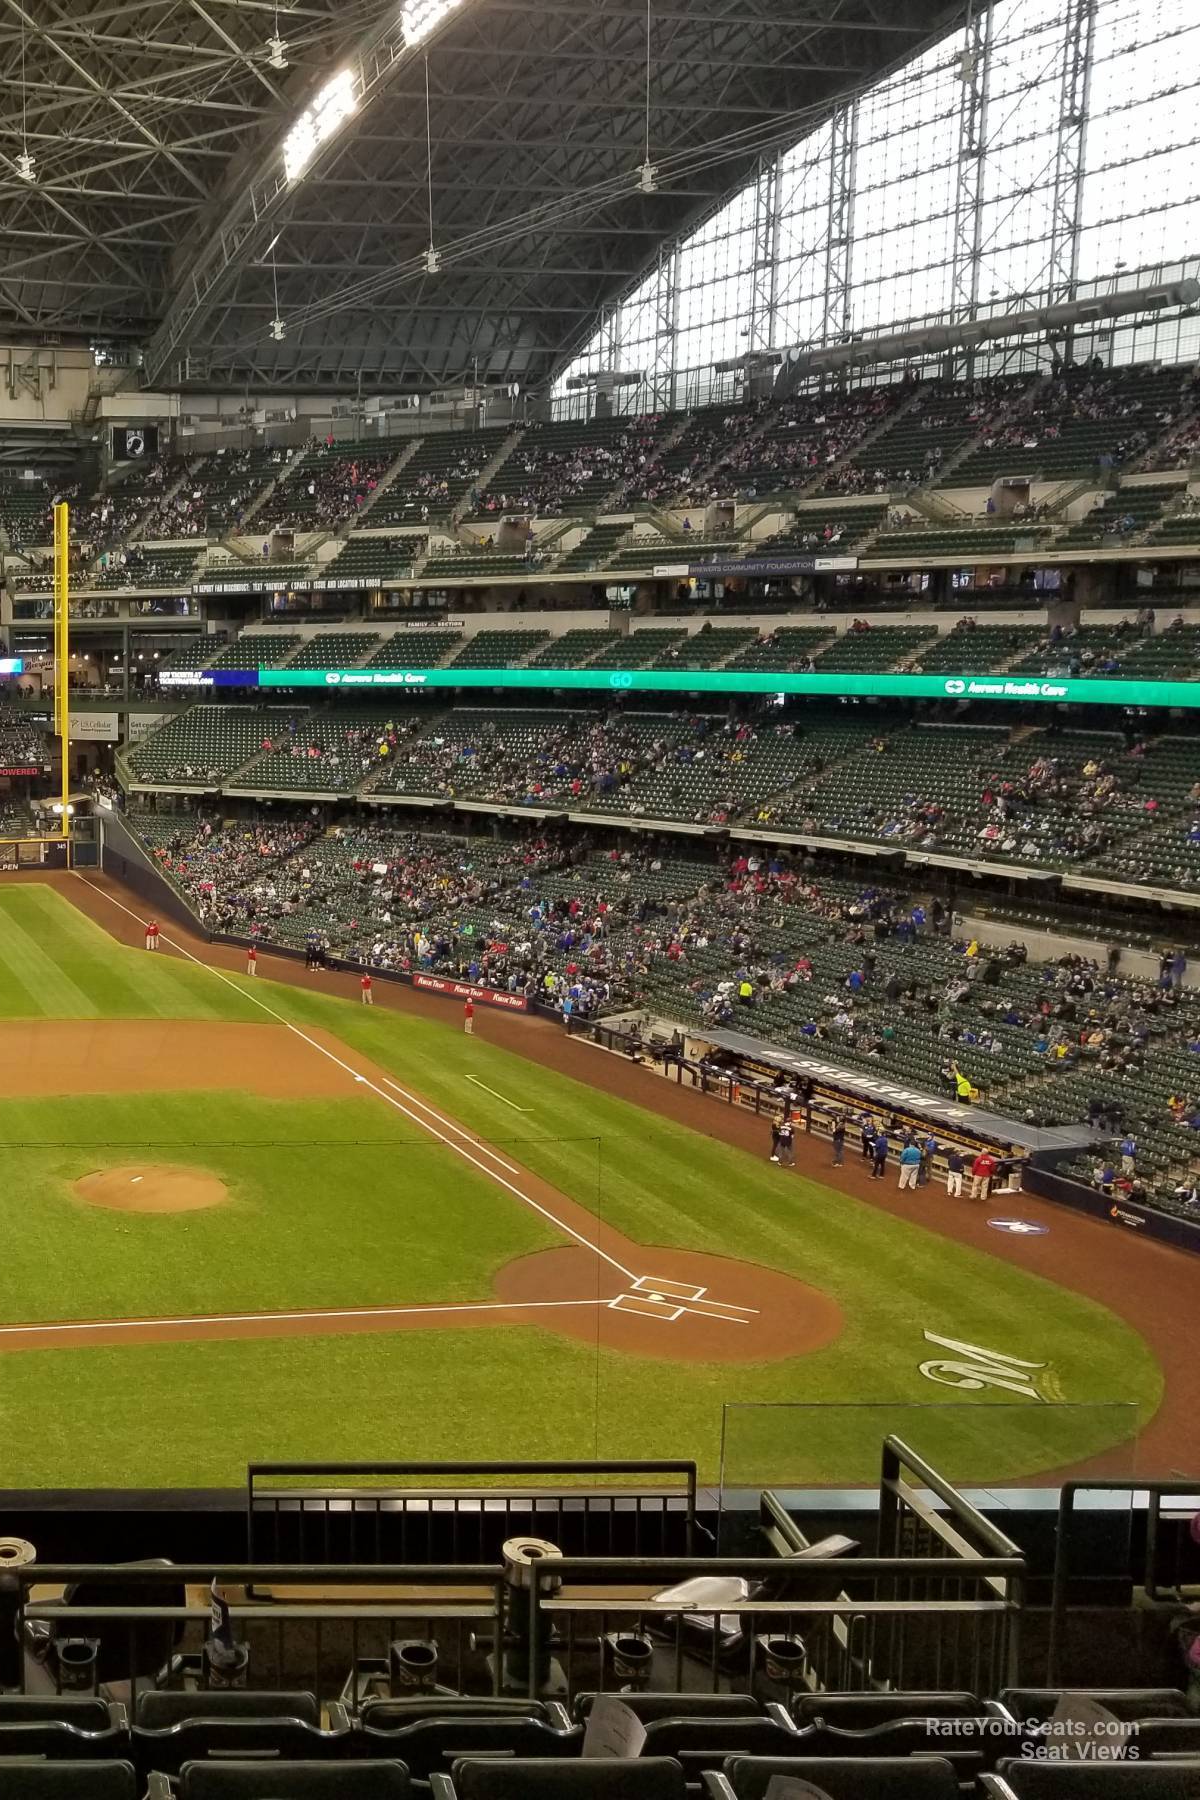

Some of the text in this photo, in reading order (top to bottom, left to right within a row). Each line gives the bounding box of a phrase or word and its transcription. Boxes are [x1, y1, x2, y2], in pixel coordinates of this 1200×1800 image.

[722, 564, 765, 572] COMMUNITY
[766, 562, 815, 570] FOUNDATION
[792, 1060, 944, 1106] BREWERS
